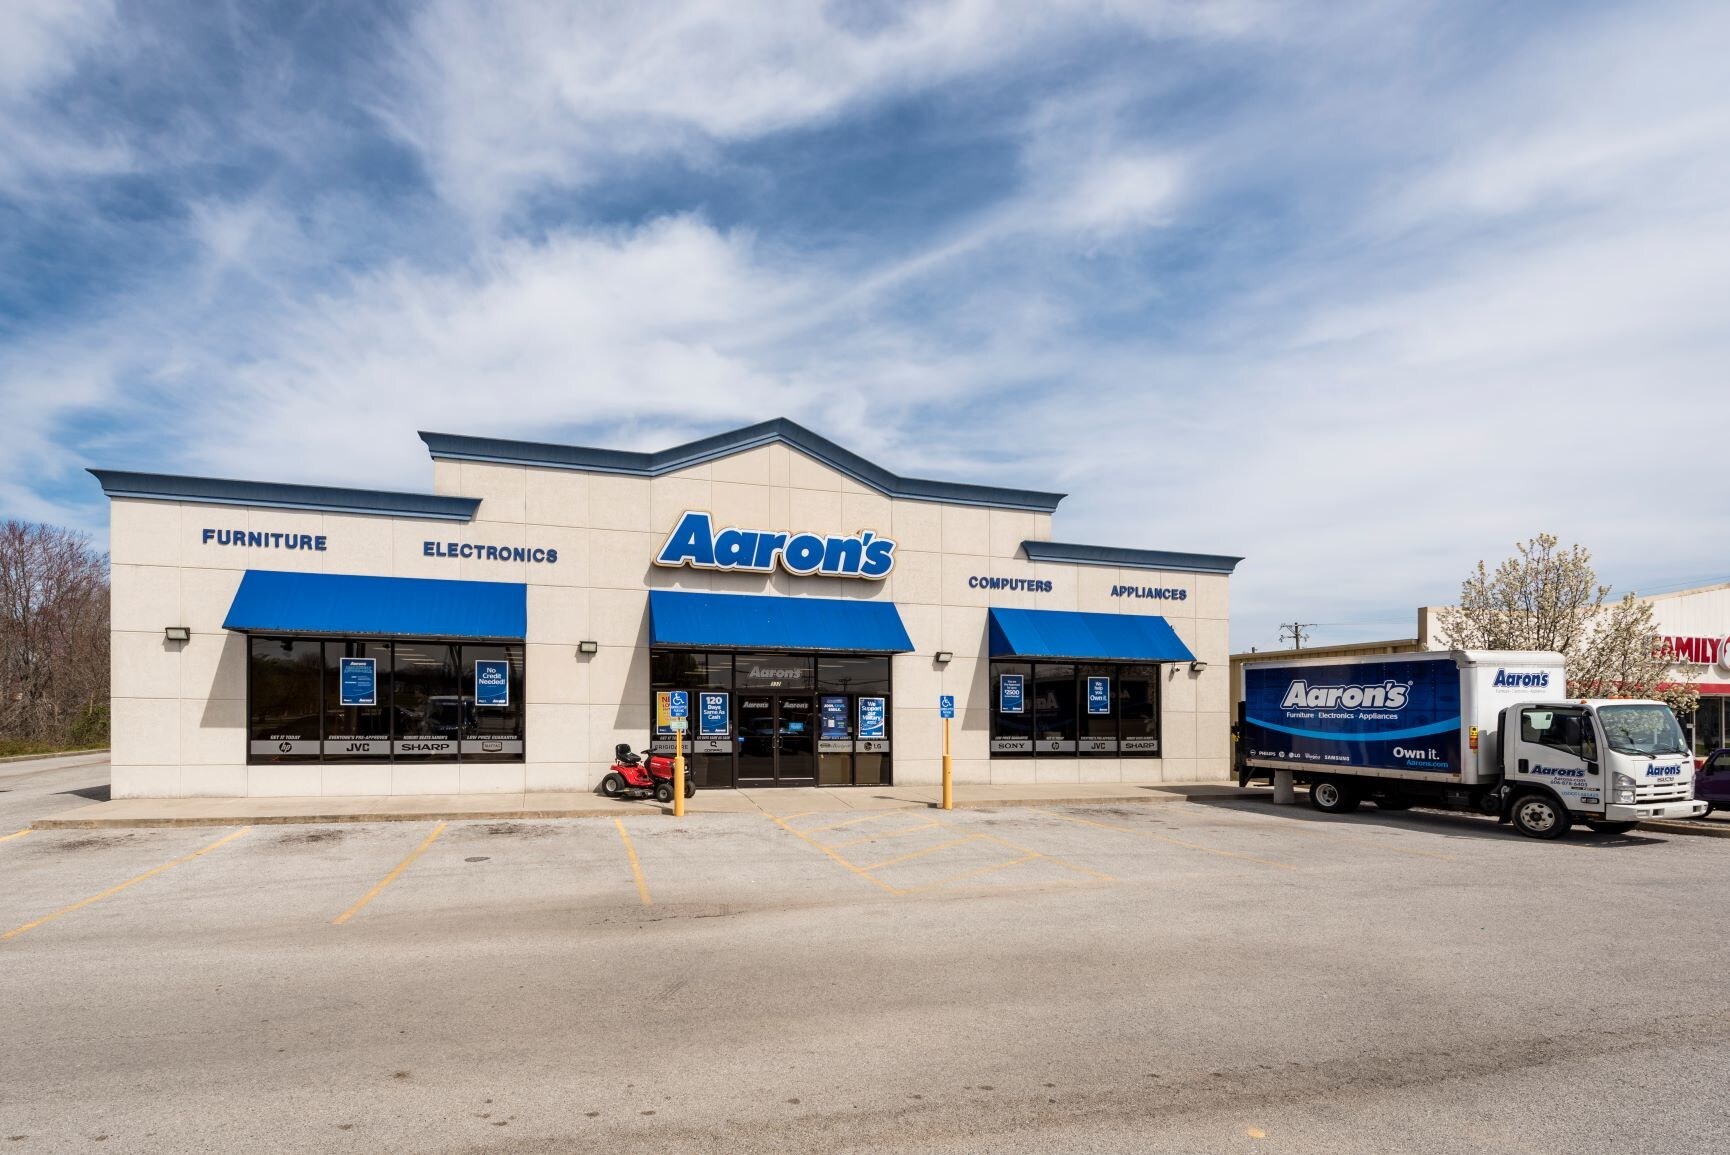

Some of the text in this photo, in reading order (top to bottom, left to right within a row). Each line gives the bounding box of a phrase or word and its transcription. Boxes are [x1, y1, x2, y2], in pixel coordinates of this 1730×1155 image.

[202, 528, 328, 551] FURNITURE
[656, 511, 897, 577] Aaron's
[423, 541, 558, 563] ELECTRONICS
[968, 576, 1053, 592] COMPUTERS
[1111, 585, 1187, 600] APPLIANCES
[1652, 636, 1721, 663] AMILY
[748, 666, 802, 679] Aaron's
[1493, 668, 1549, 688] Aaron's
[705, 696, 723, 705] 120
[1281, 680, 1410, 709] Aaron's
[1358, 712, 1398, 720] Appliances
[346, 743, 370, 752] JVC
[401, 743, 450, 751] SHARP
[1091, 742, 1106, 750] JVC
[1393, 746, 1440, 760] Own it.
[1406, 759, 1449, 768] Aarons.com
[1531, 764, 1585, 777] Aaron's
[1646, 763, 1681, 777] Aaron's
